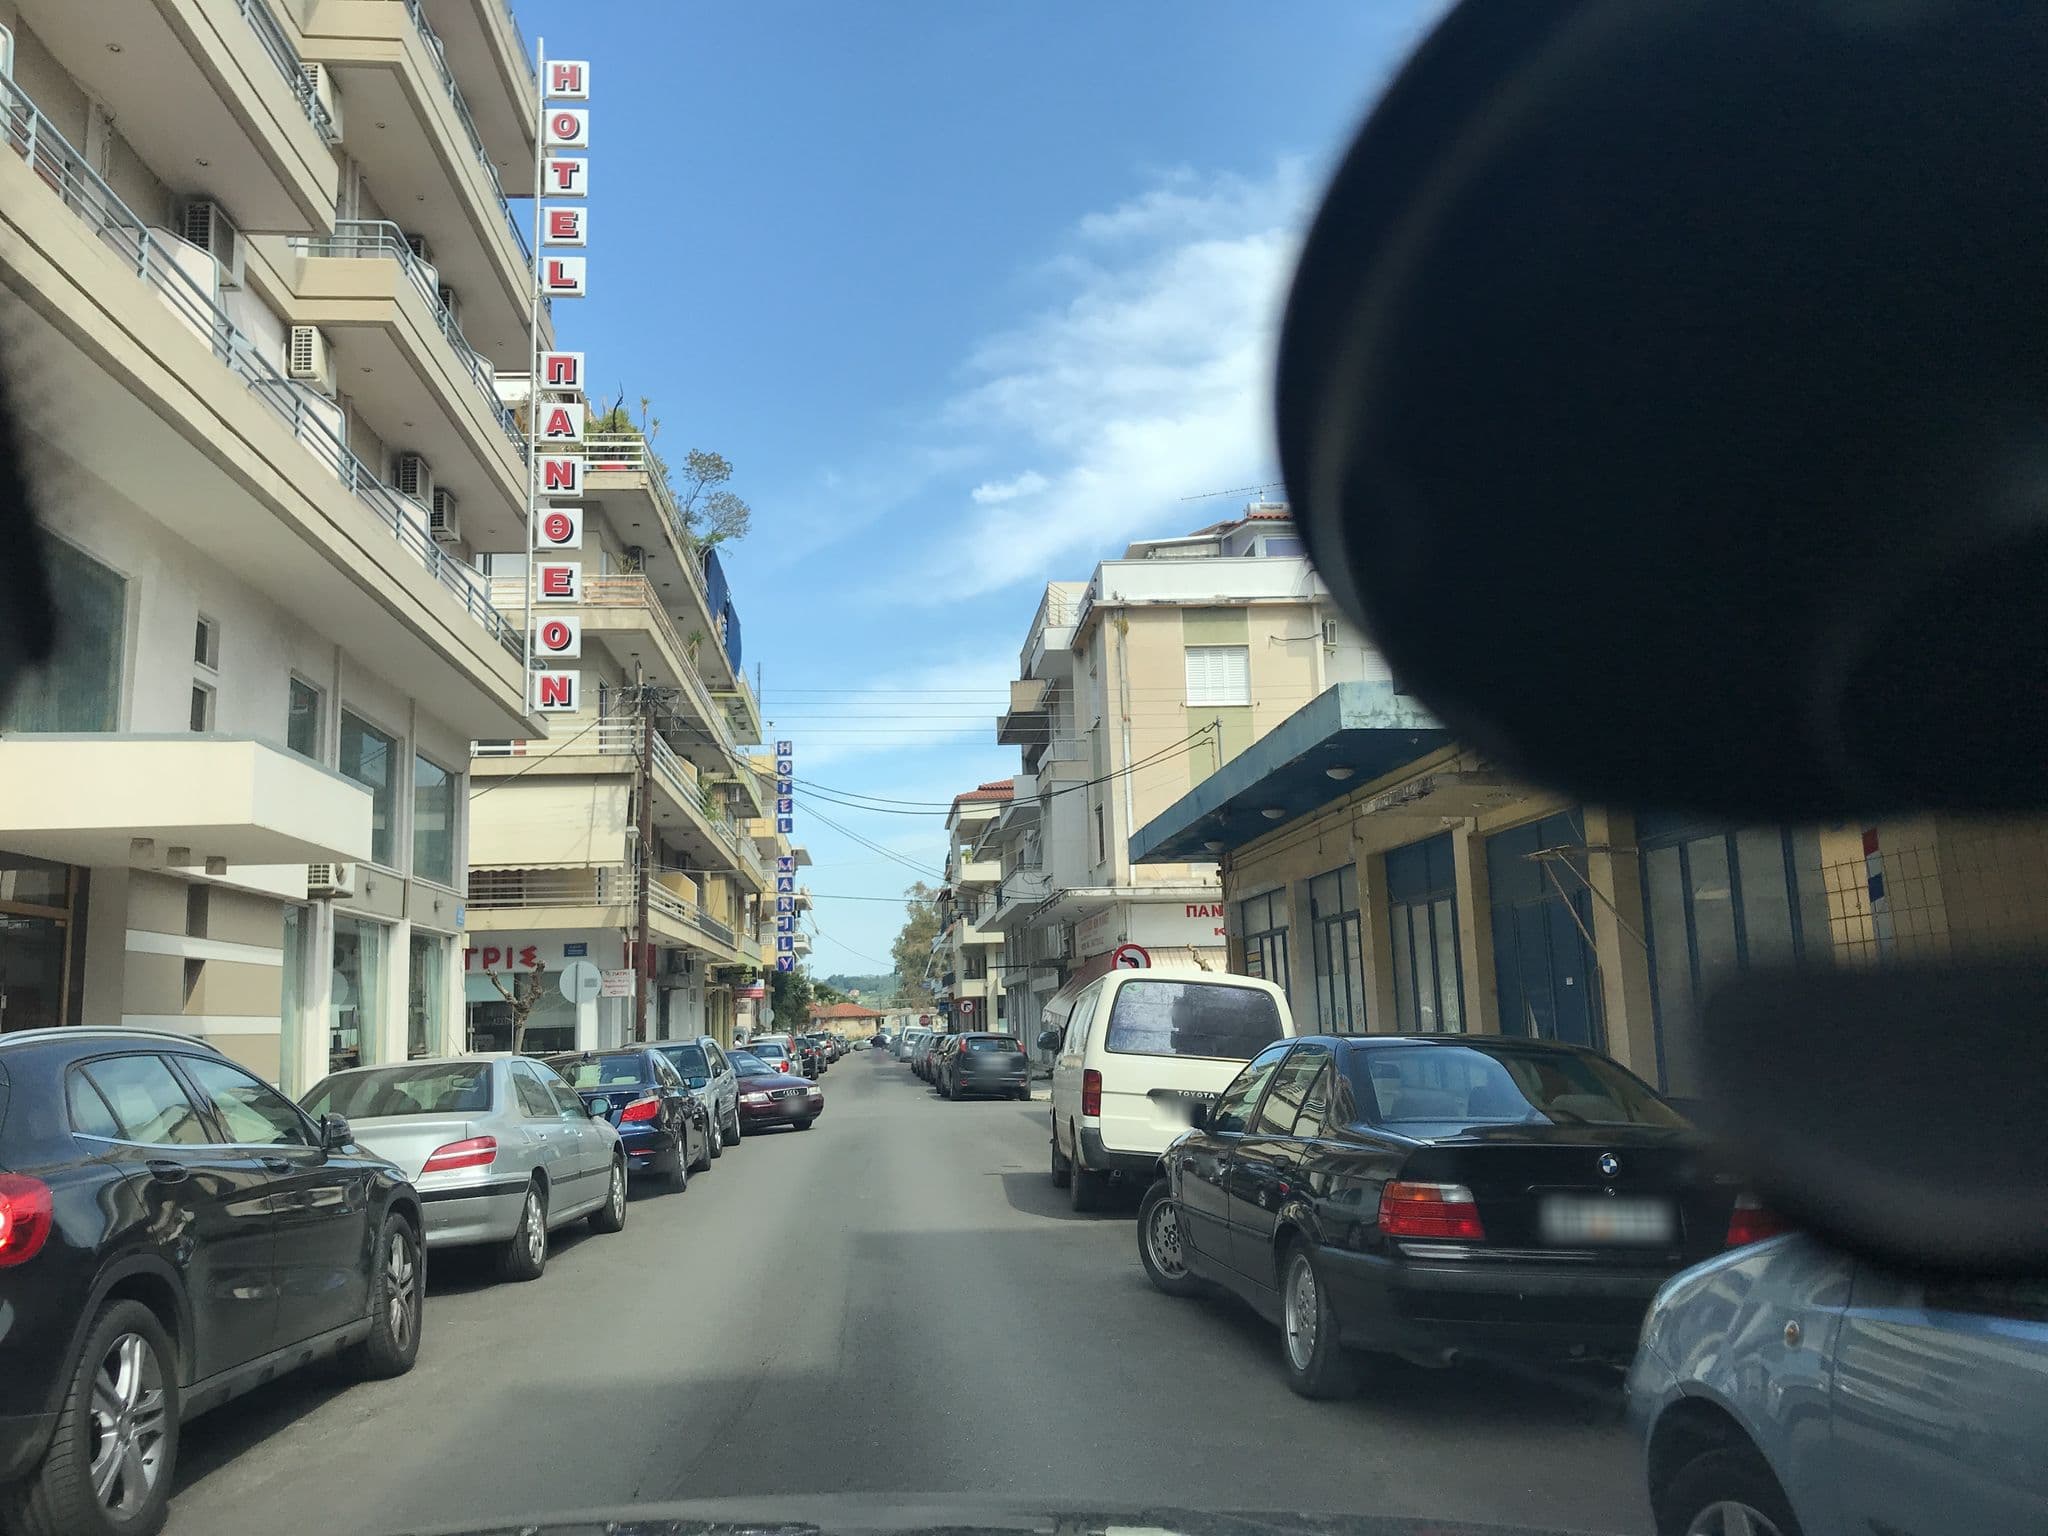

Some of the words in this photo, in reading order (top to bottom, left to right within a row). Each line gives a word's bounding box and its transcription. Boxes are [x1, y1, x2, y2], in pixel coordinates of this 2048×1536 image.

[548, 63, 582, 289] HOTEL
[540, 355, 577, 707] ΠΑΝΘΕΟΝ
[779, 741, 792, 832] HOTEL
[1177, 1090, 1215, 1099] TOYOTA
